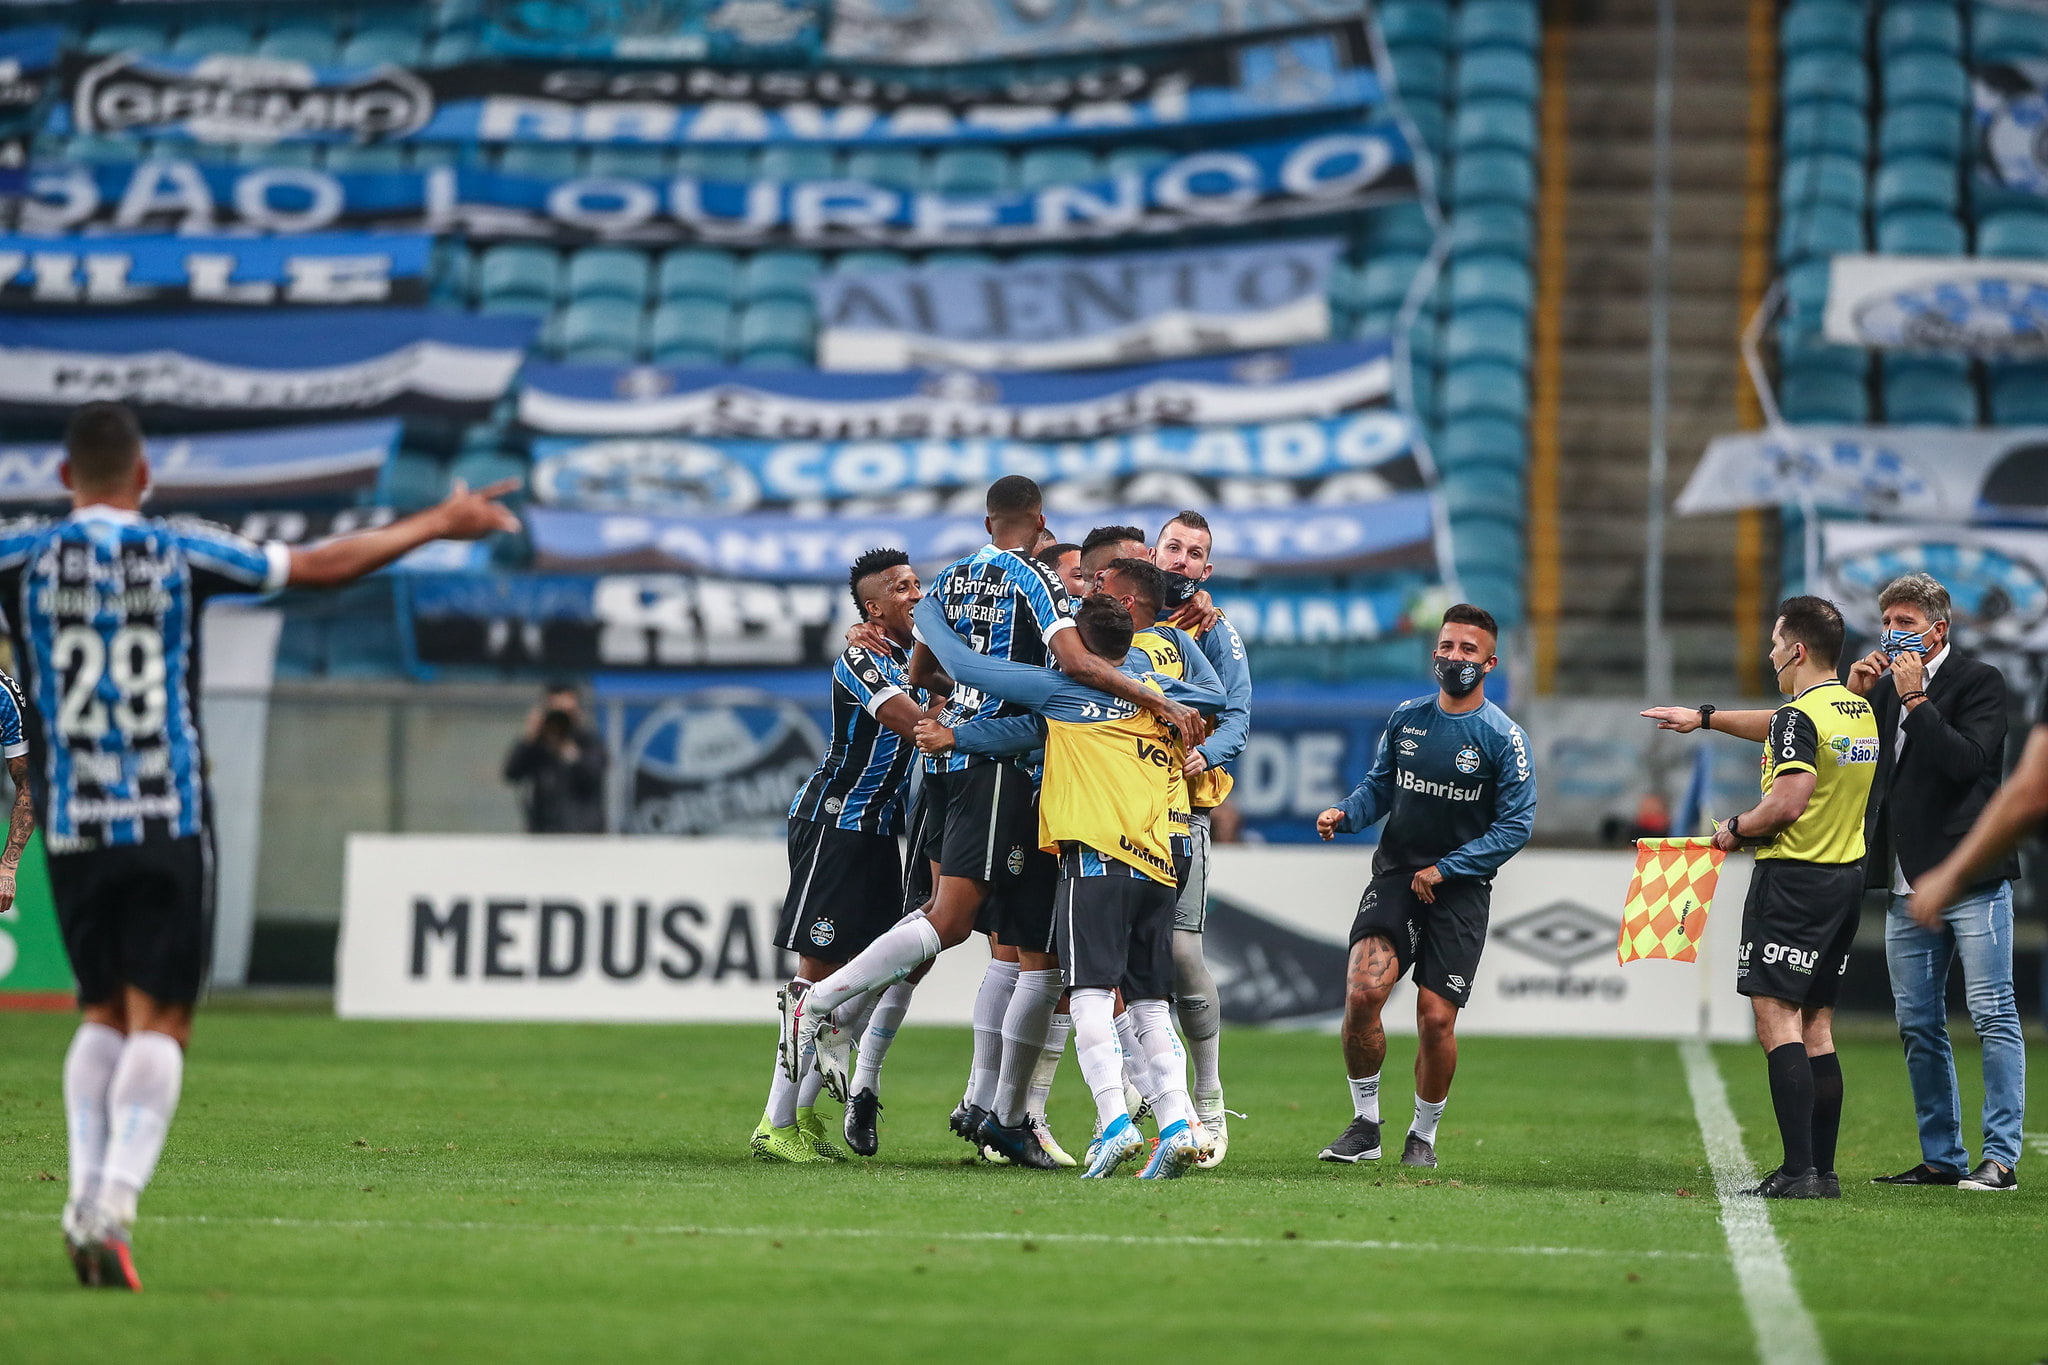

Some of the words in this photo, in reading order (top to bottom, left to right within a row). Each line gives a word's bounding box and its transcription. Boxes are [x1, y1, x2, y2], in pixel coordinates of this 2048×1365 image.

[764, 409, 1414, 497] CONSULADO
[954, 577, 1010, 598] Banrisul
[52, 624, 166, 738] 29
[1402, 725, 1428, 737] betsul
[1508, 724, 1529, 767] vero
[1850, 745, 1870, 762] São
[1403, 771, 1483, 802] Banrisul
[1762, 943, 1815, 969] grau
[1496, 972, 1625, 1001] umbro
